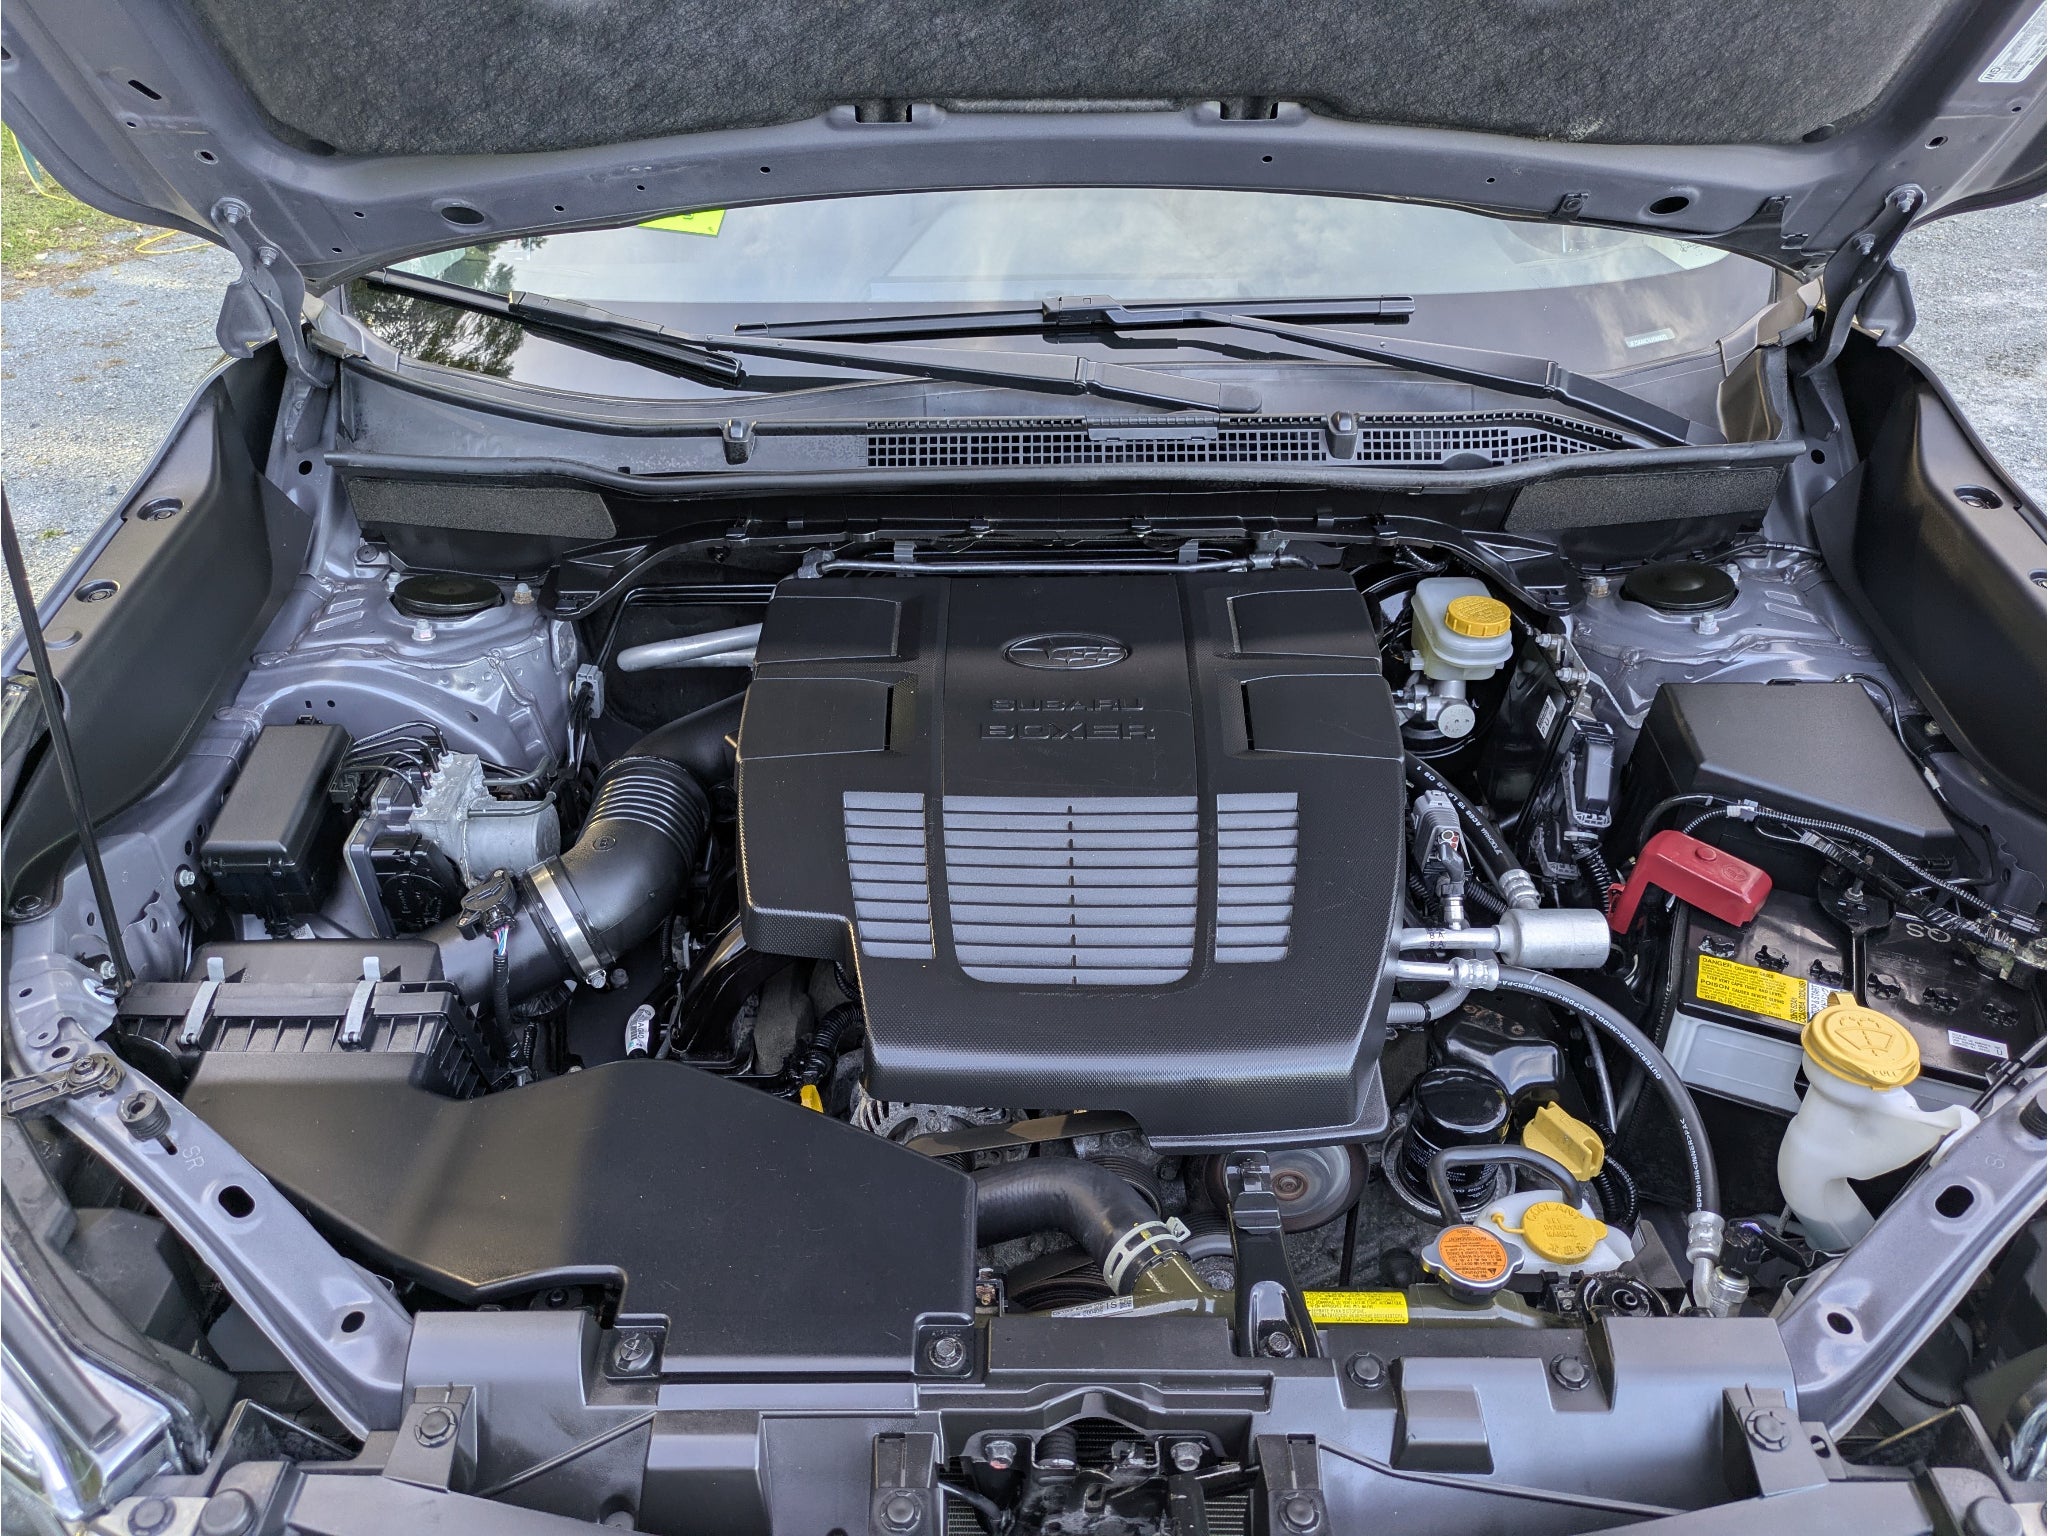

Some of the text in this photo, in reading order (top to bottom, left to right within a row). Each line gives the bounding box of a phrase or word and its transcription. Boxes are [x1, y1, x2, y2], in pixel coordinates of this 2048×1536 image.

[990, 698, 1145, 712] SUBARU
[979, 721, 1156, 740] BOXER
[1702, 958, 1732, 969] DANGER
[1700, 979, 1730, 991] POISON
[1732, 988, 1750, 996] CAUSES
[182, 1145, 205, 1171] SR
[1526, 1203, 1584, 1221] COOLANT
